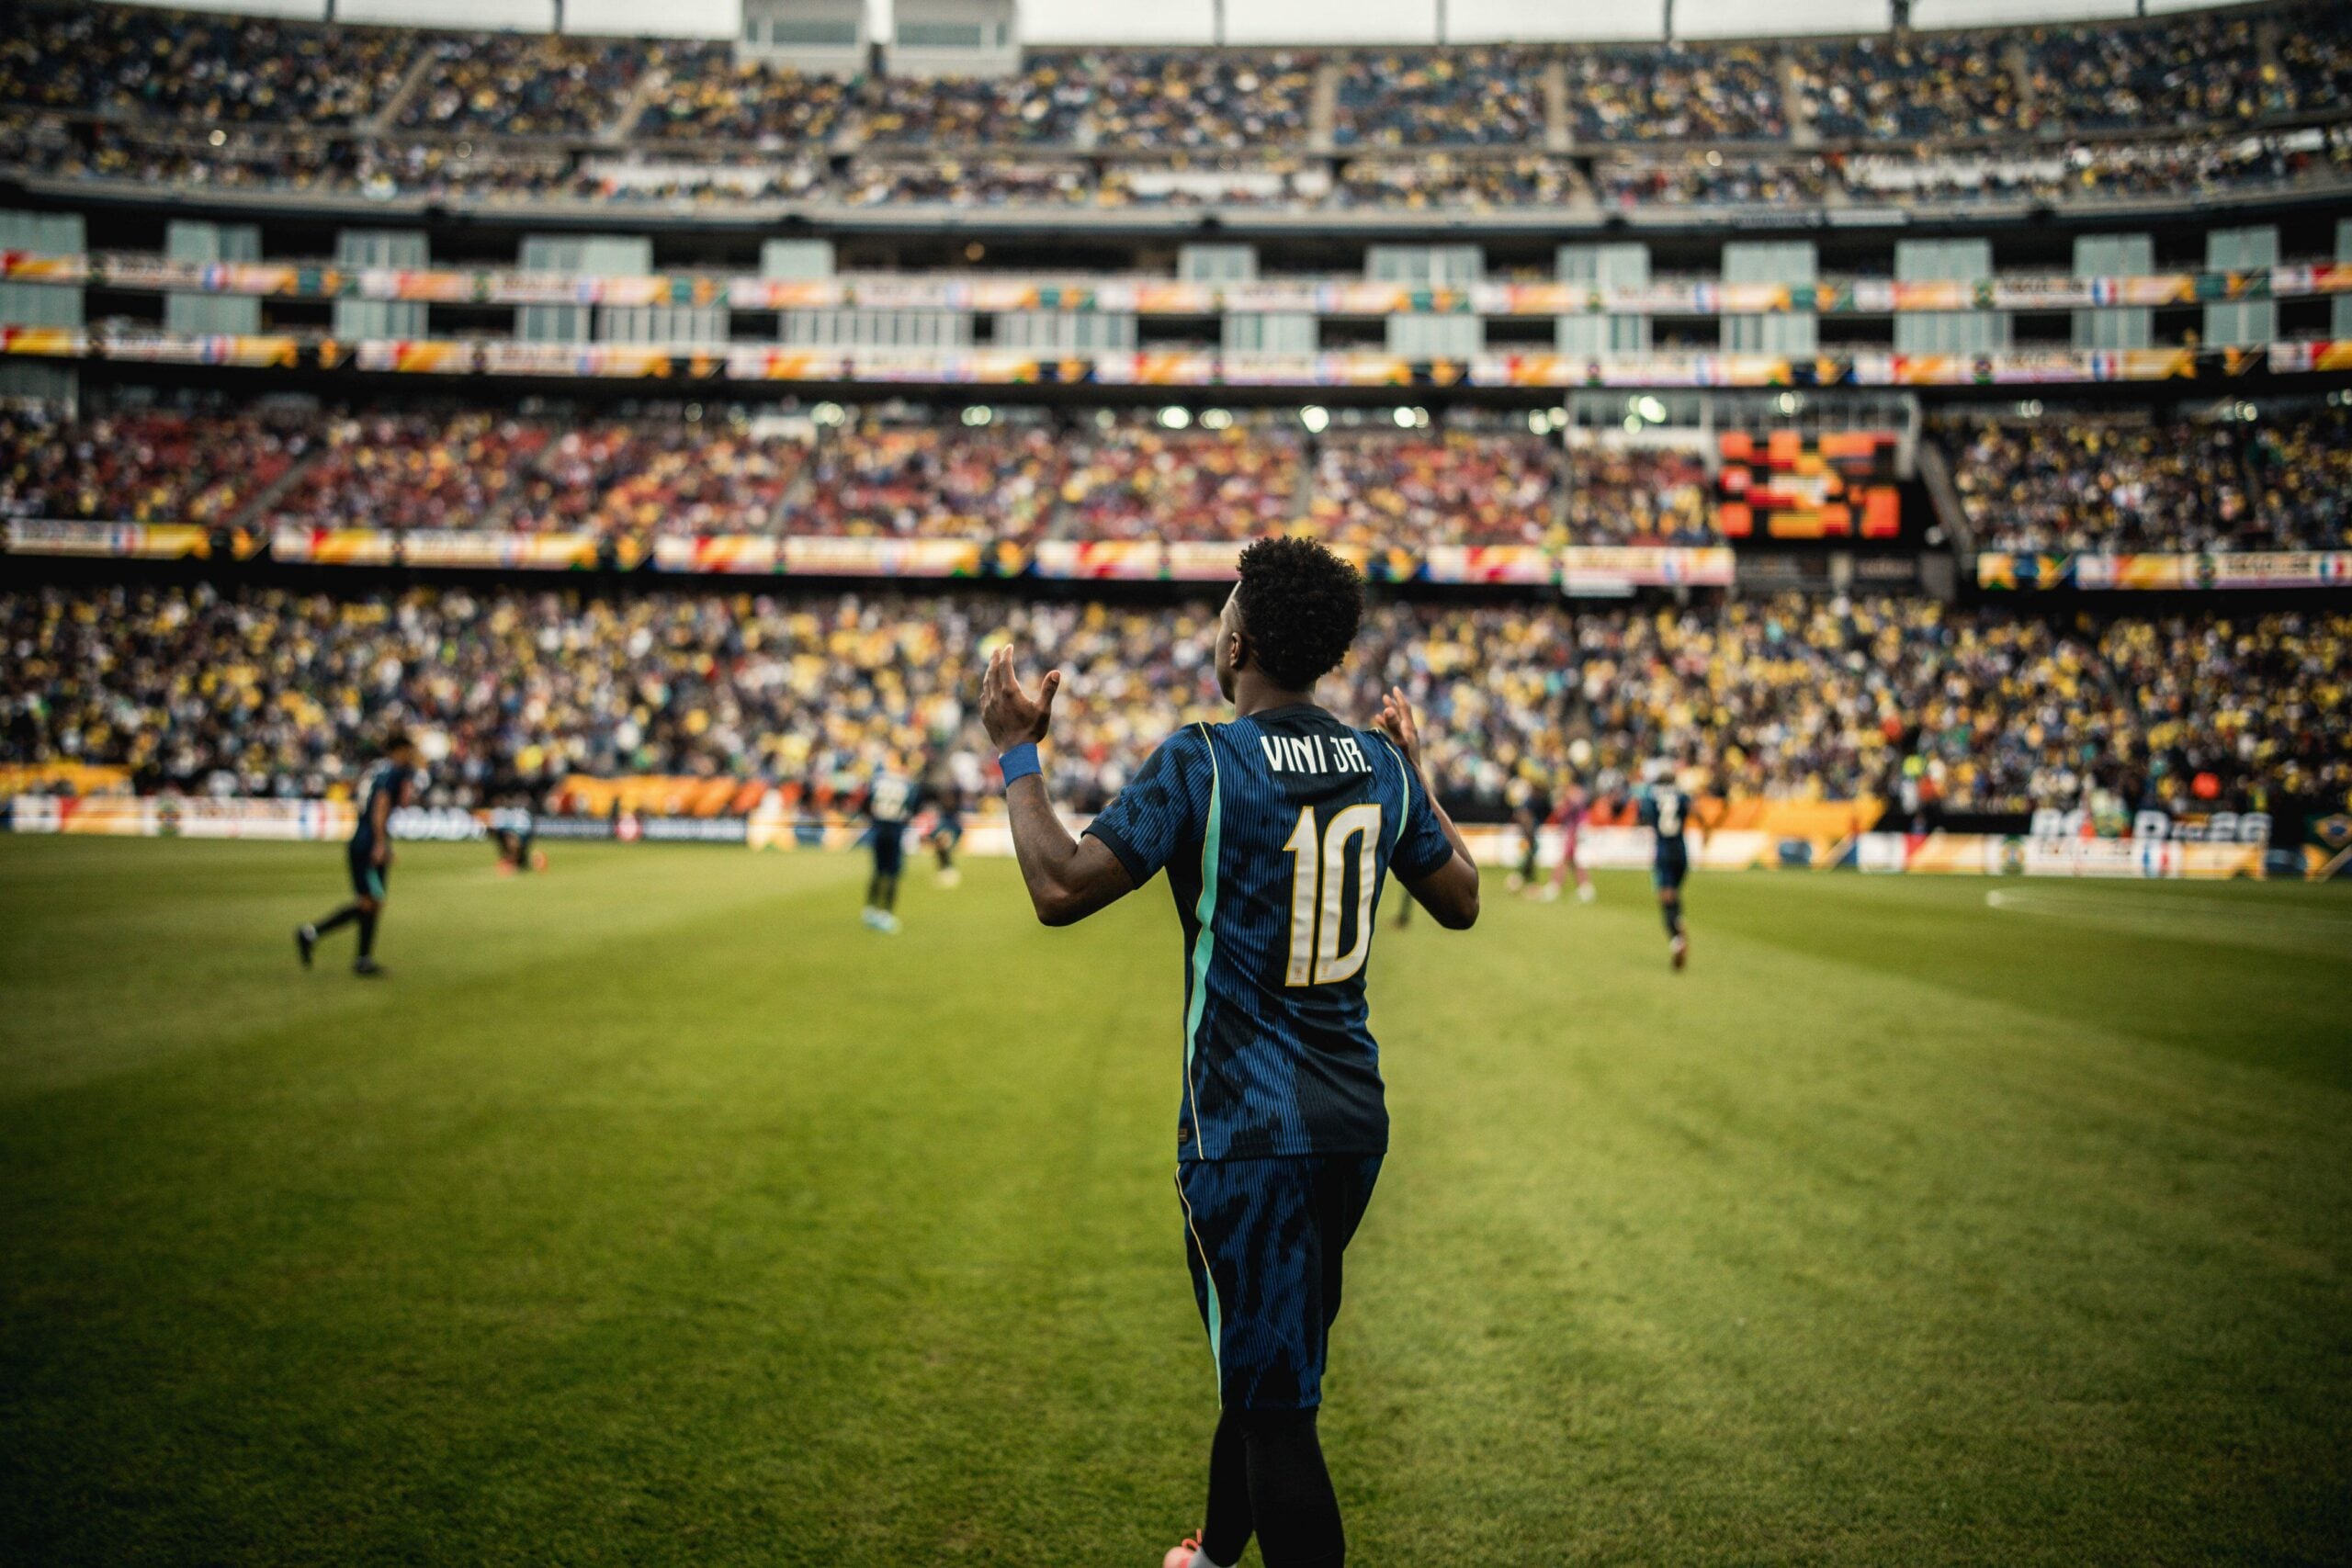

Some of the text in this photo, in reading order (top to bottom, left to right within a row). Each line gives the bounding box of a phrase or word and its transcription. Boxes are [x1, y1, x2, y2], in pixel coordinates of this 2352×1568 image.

[1260, 735, 1372, 773] VINI JR.
[1283, 804, 1382, 987] 10
